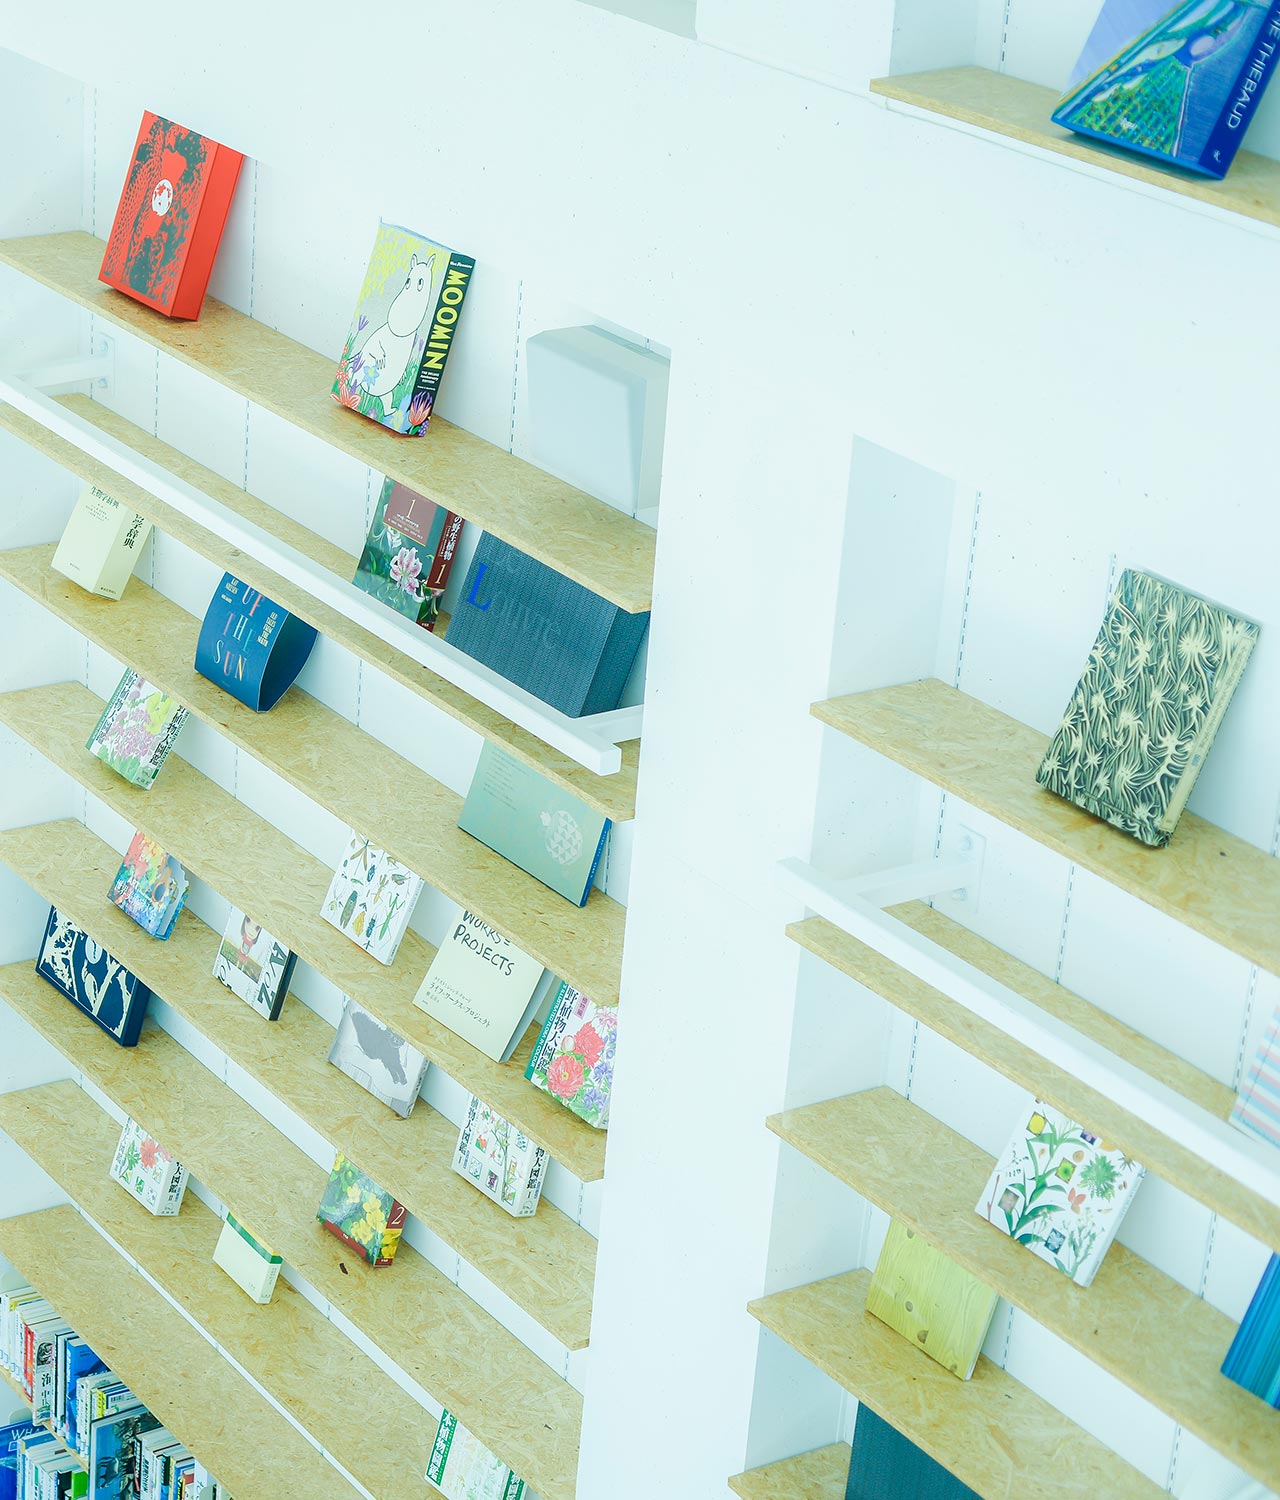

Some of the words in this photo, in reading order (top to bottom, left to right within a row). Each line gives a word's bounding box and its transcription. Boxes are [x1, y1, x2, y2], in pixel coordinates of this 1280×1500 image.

[1228, 41, 1276, 129] THIEBAUD
[422, 269, 469, 370] MOOMIN
[213, 639, 248, 681] SUN
[453, 924, 515, 976] PROJECTS
[542, 1021, 552, 1038] FLORA
[530, 1045, 542, 1068] COLOUR
[391, 1206, 405, 1225] 2
